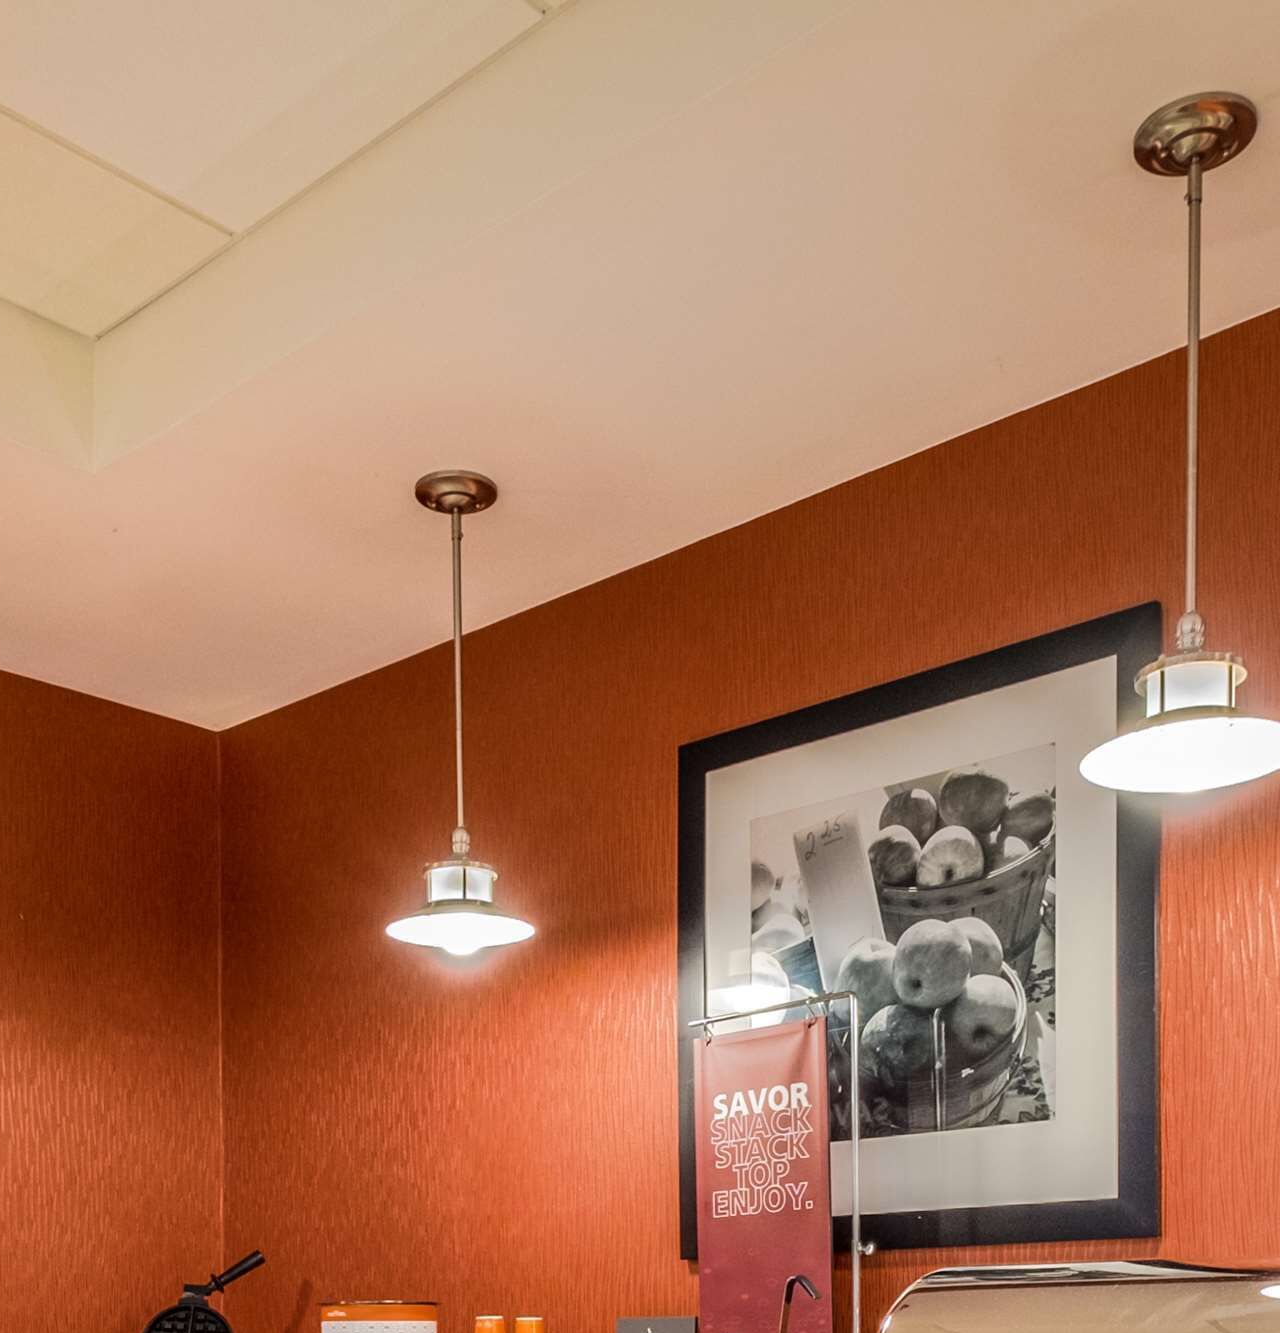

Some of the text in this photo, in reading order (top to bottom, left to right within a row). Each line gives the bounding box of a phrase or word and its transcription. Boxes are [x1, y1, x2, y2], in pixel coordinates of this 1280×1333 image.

[712, 1082, 810, 1120] SAVOR
[710, 1103, 814, 1147] SNACK
[715, 1131, 810, 1169] STACK
[732, 1159, 790, 1190] TOP
[712, 1181, 814, 1218] ENJOY.
